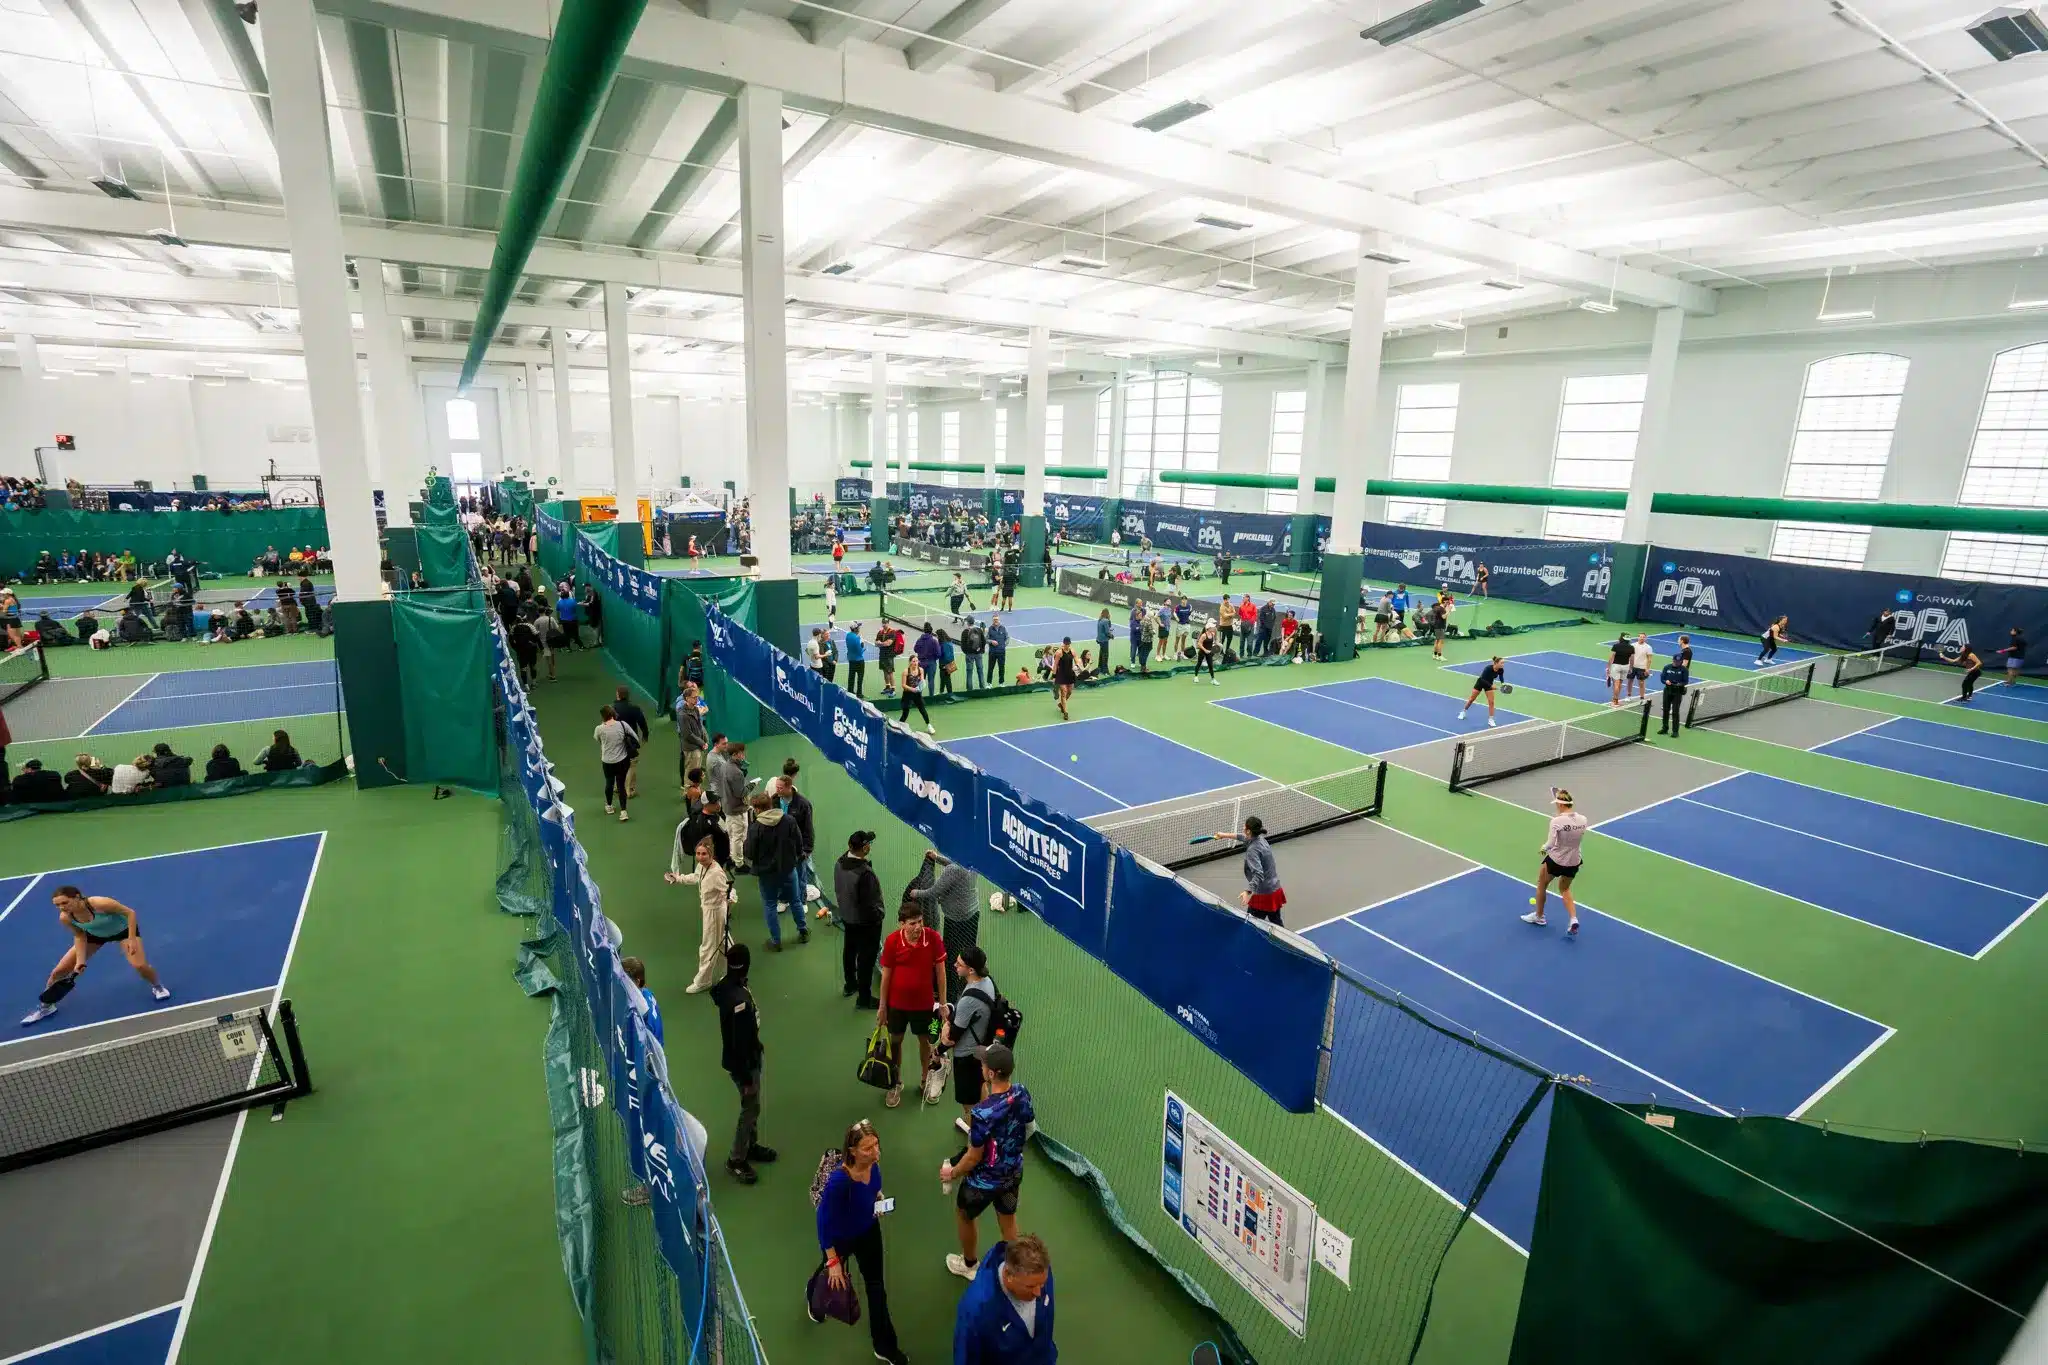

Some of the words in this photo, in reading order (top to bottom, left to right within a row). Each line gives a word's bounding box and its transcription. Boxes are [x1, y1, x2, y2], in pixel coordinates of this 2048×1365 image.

[1198, 525, 1223, 546] PPA
[1435, 553, 1477, 580] PPA
[1677, 565, 1721, 577] CARVANA
[1655, 576, 1719, 610] PPA
[1916, 594, 1974, 607] CARVANA
[1653, 602, 1696, 614] PICKLEBALL
[1697, 608, 1718, 617] TOUR
[1892, 608, 1970, 646] PPA
[1002, 808, 1069, 873] ACRYTECH
[1008, 840, 1028, 861] SPORTS
[1029, 854, 1061, 880] SURFACES
[1019, 888, 1032, 902] PPA
[1177, 1005, 1194, 1025] PPA
[1187, 1004, 1210, 1027] CARVANA
[226, 1030, 246, 1040] COURT
[1321, 1227, 1345, 1248] COURTS
[1321, 1237, 1342, 1258] 9-12
